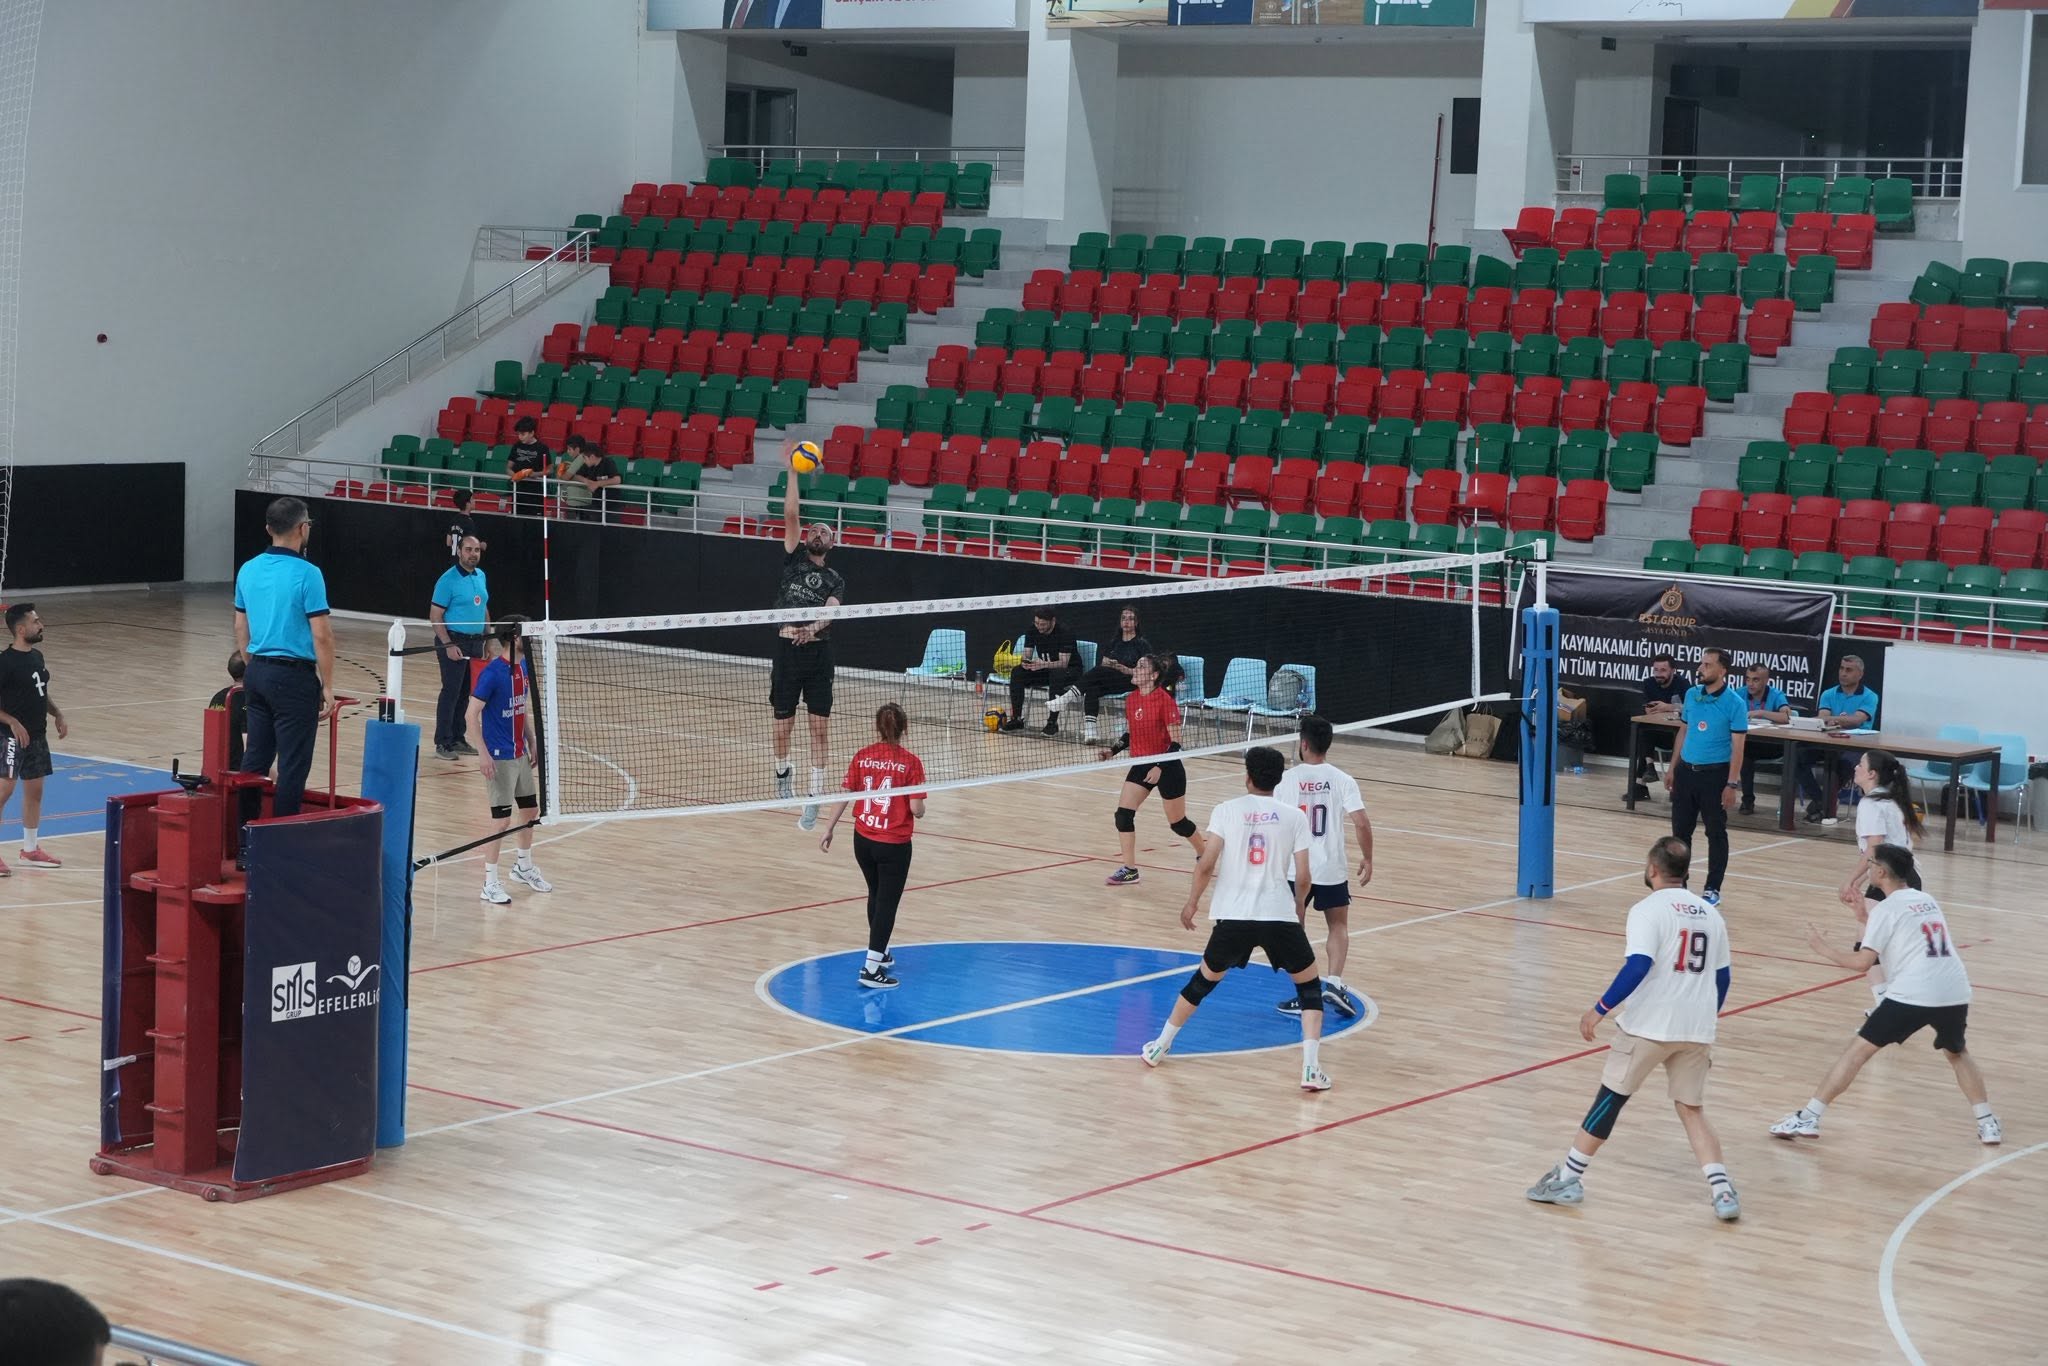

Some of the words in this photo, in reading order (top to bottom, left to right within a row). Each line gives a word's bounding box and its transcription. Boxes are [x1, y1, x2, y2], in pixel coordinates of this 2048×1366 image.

[1638, 613, 1660, 624] RST
[1660, 615, 1697, 628] GROUP
[1560, 633, 1652, 659] KAYMAKAMLIĞI
[1654, 642, 1710, 664] VOLEYB
[1569, 656, 1597, 678] TÜM
[31, 671, 46, 697] 7
[857, 757, 907, 773] TÜRKİYE
[1299, 781, 1331, 792] VEGA
[862, 775, 893, 815] 14
[1243, 811, 1280, 823] VEGA
[1671, 902, 1707, 916] VEGA
[1908, 903, 1938, 913] VEGA
[1673, 928, 1709, 975] 19
[285, 1010, 302, 1019] GRUP
